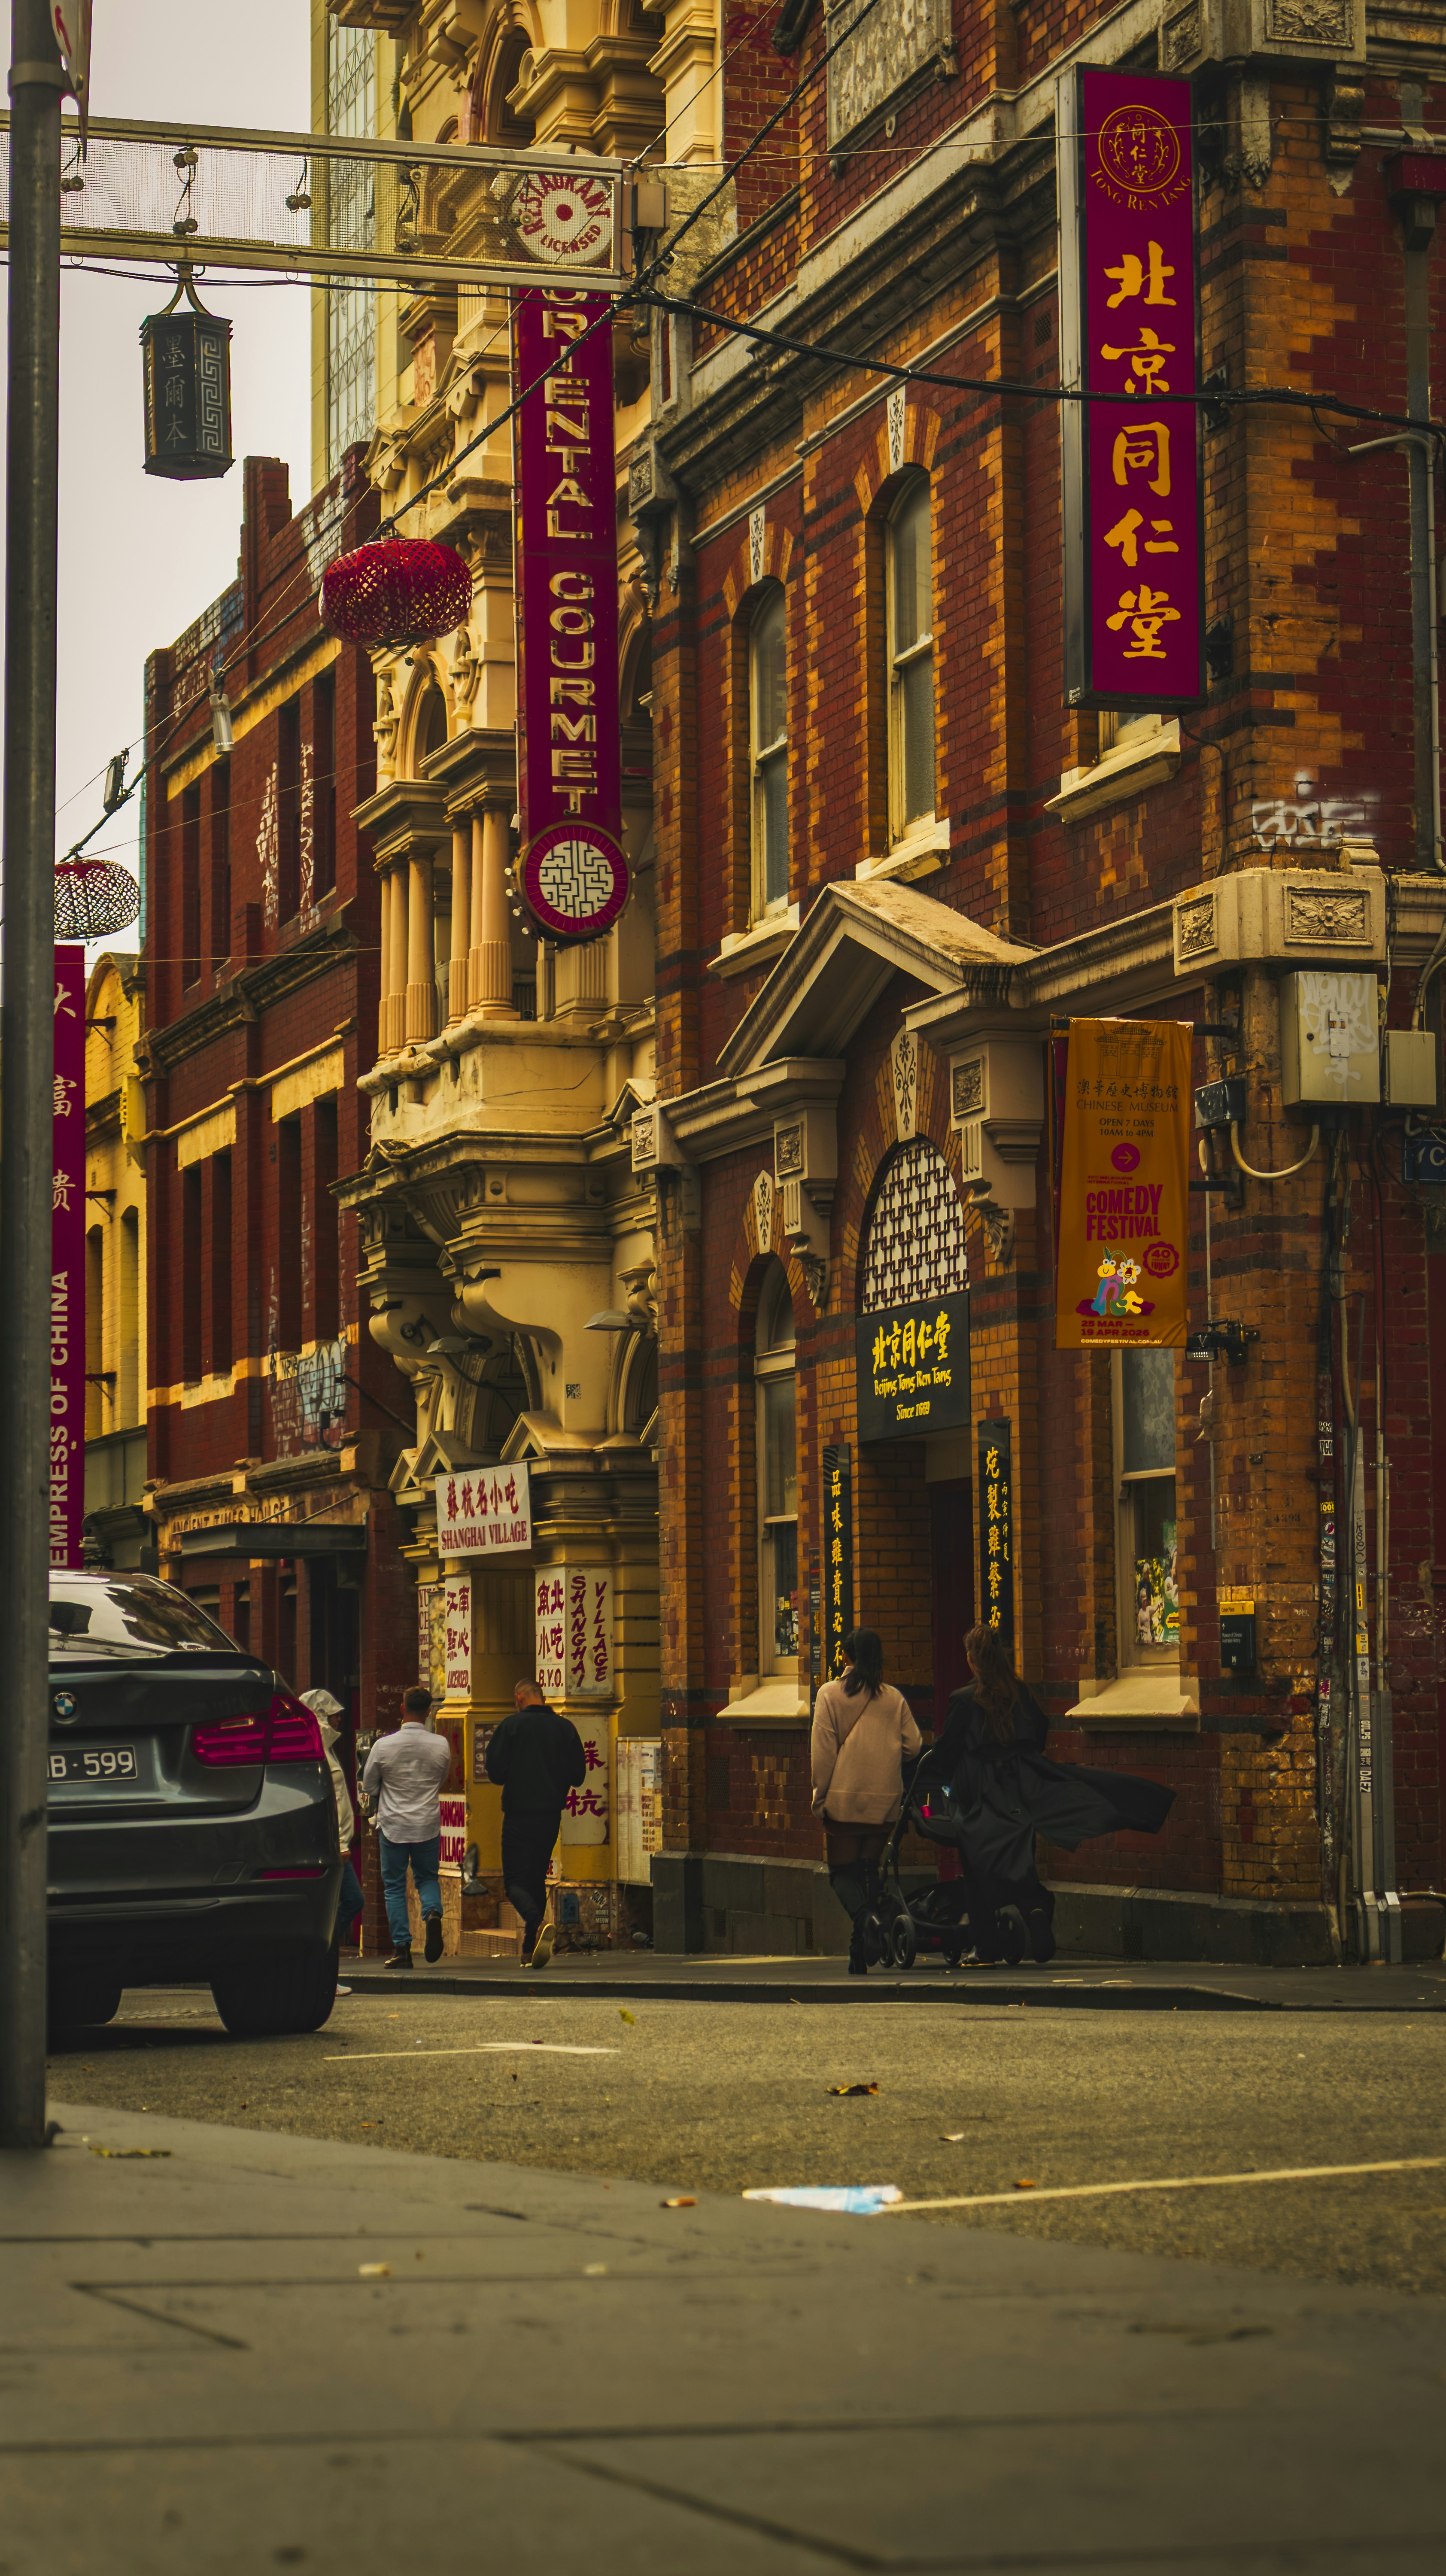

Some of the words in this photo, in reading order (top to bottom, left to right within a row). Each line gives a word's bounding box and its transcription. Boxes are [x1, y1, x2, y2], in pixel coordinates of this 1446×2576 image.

[1130, 123, 1148, 184] 同仁堂
[1090, 166, 1123, 204] TONG
[1127, 194, 1158, 211] REN
[1158, 175, 1192, 207] TANG
[541, 225, 601, 254] LICENSED
[161, 335, 188, 449] 墨爾本
[542, 289, 594, 539] ORIENTAL
[1101, 240, 1181, 659] 北京同仁堂
[549, 571, 598, 814] GOURMET
[1077, 1100, 1123, 1111] CHINESE
[1129, 1102, 1178, 1112] MUSEUM
[1100, 1118, 1123, 1126] OPEN
[1086, 1184, 1163, 1215] COMEDY
[1086, 1215, 1161, 1241] FESTIVAL
[1151, 1250, 1170, 1258] 40
[1151, 1262, 1170, 1271] FUNNY
[50, 1271, 68, 1366] CHINA
[872, 1311, 951, 1375] 北京同仁堂
[50, 1376, 68, 1414] OF
[874, 1379, 898, 1398] Beijing
[897, 1373, 916, 1394] Tong
[916, 1370, 931, 1388] Ren
[931, 1367, 952, 1387] Tang
[896, 1404, 914, 1421] Since
[915, 1401, 930, 1416] 1669
[49, 1425, 69, 1566] EMPRESS
[447, 1473, 519, 1522] 蘇杭名小吃
[173, 1516, 210, 1533] ANCIENT
[215, 1510, 243, 1523] TIMES
[441, 1526, 486, 1550] SHANGHAI
[489, 1520, 527, 1544] VILLAGE
[419, 1634, 428, 1645] SPEC
[538, 1622, 564, 1660] 小吃
[570, 1576, 587, 1687] SHANGHAI
[592, 1581, 608, 1682] VILLAGE
[447, 1670, 469, 1688] LICENSED
[538, 1668, 563, 1687] B.Y.O.
[1360, 1720, 1371, 1740] GULPS
[1360, 1771, 1371, 1792] DAEZ
[440, 1801, 465, 1827] HANGHAI
